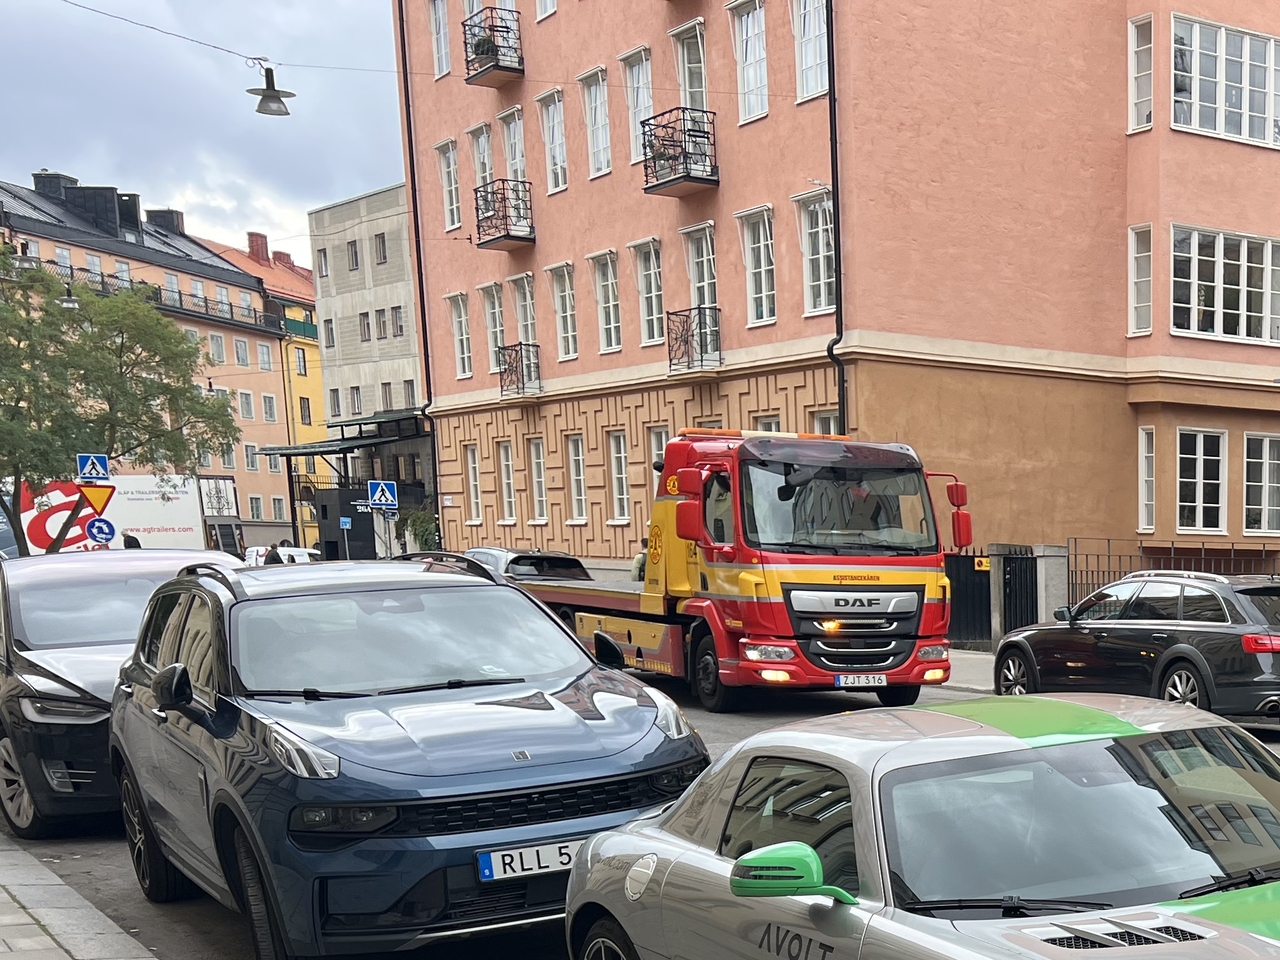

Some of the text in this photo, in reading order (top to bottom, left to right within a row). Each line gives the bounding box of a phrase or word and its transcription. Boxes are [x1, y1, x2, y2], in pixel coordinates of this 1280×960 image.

[834, 598, 880, 607] DAF
[843, 675, 883, 685] ZJT 316
[501, 849, 550, 875] RLL
